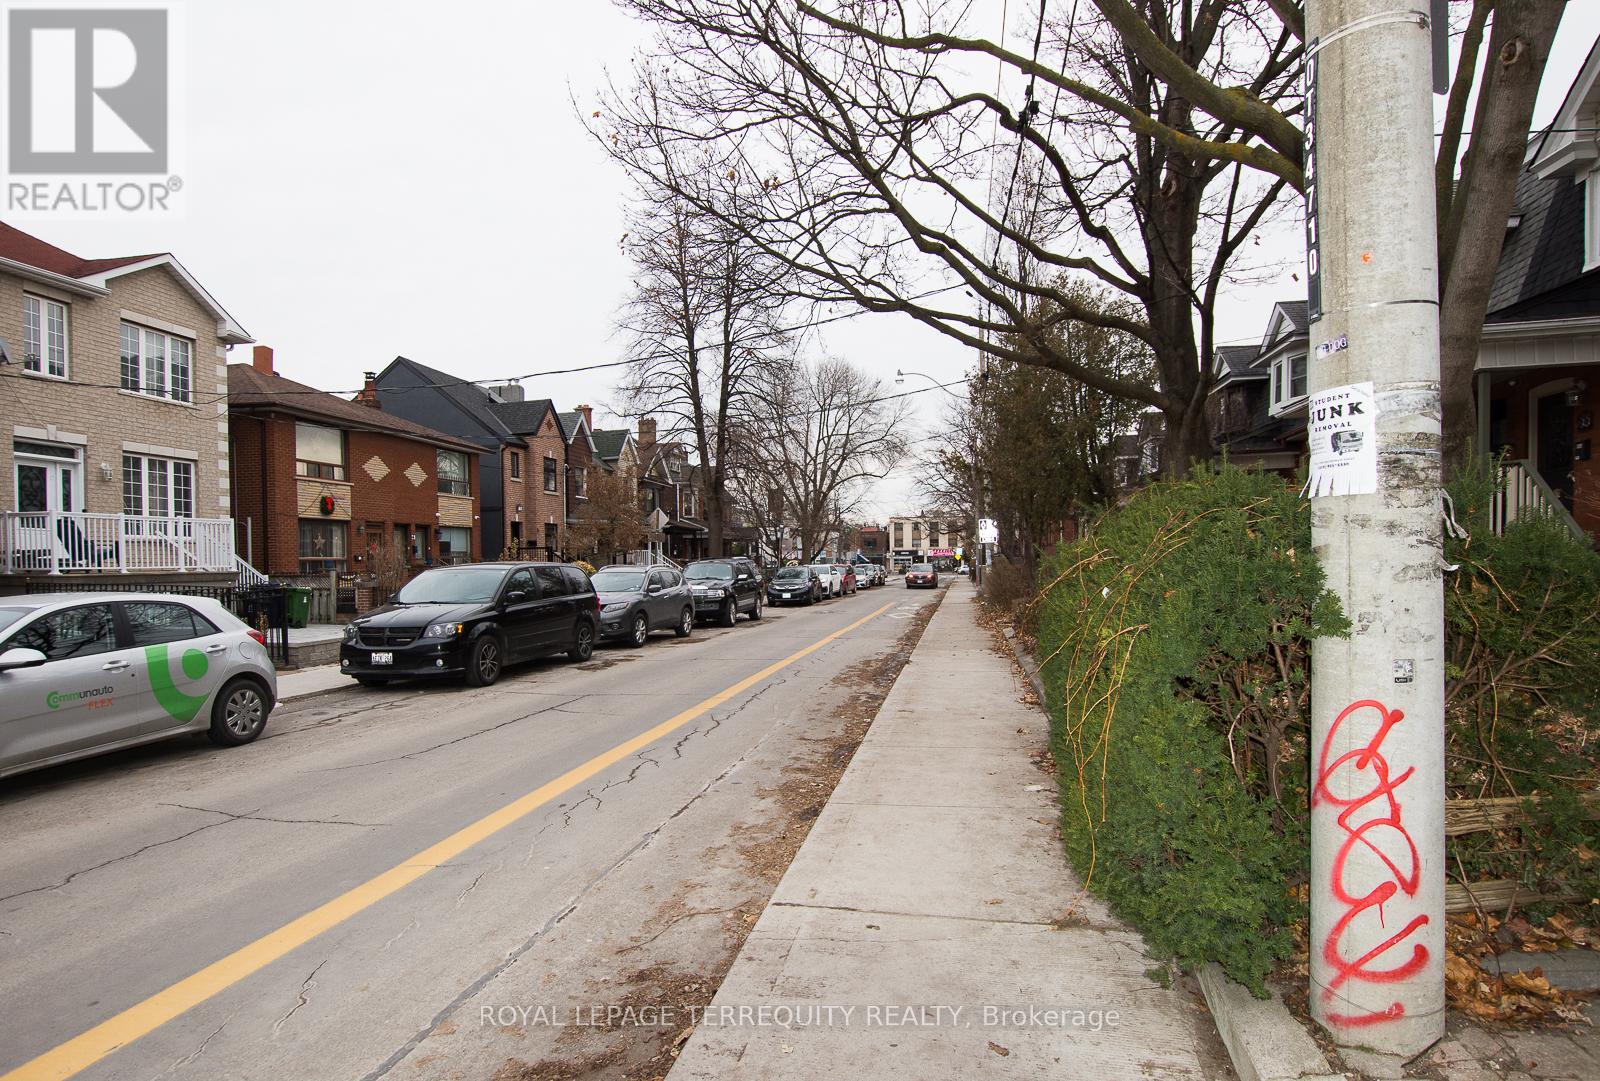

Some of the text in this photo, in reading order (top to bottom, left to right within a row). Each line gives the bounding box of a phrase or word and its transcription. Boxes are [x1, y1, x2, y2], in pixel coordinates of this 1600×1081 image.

[1315, 393, 1350, 406] STUDENT
[1311, 402, 1365, 424] JUNK
[1314, 421, 1352, 432] REMOVAL
[46, 686, 114, 709] Communauto
